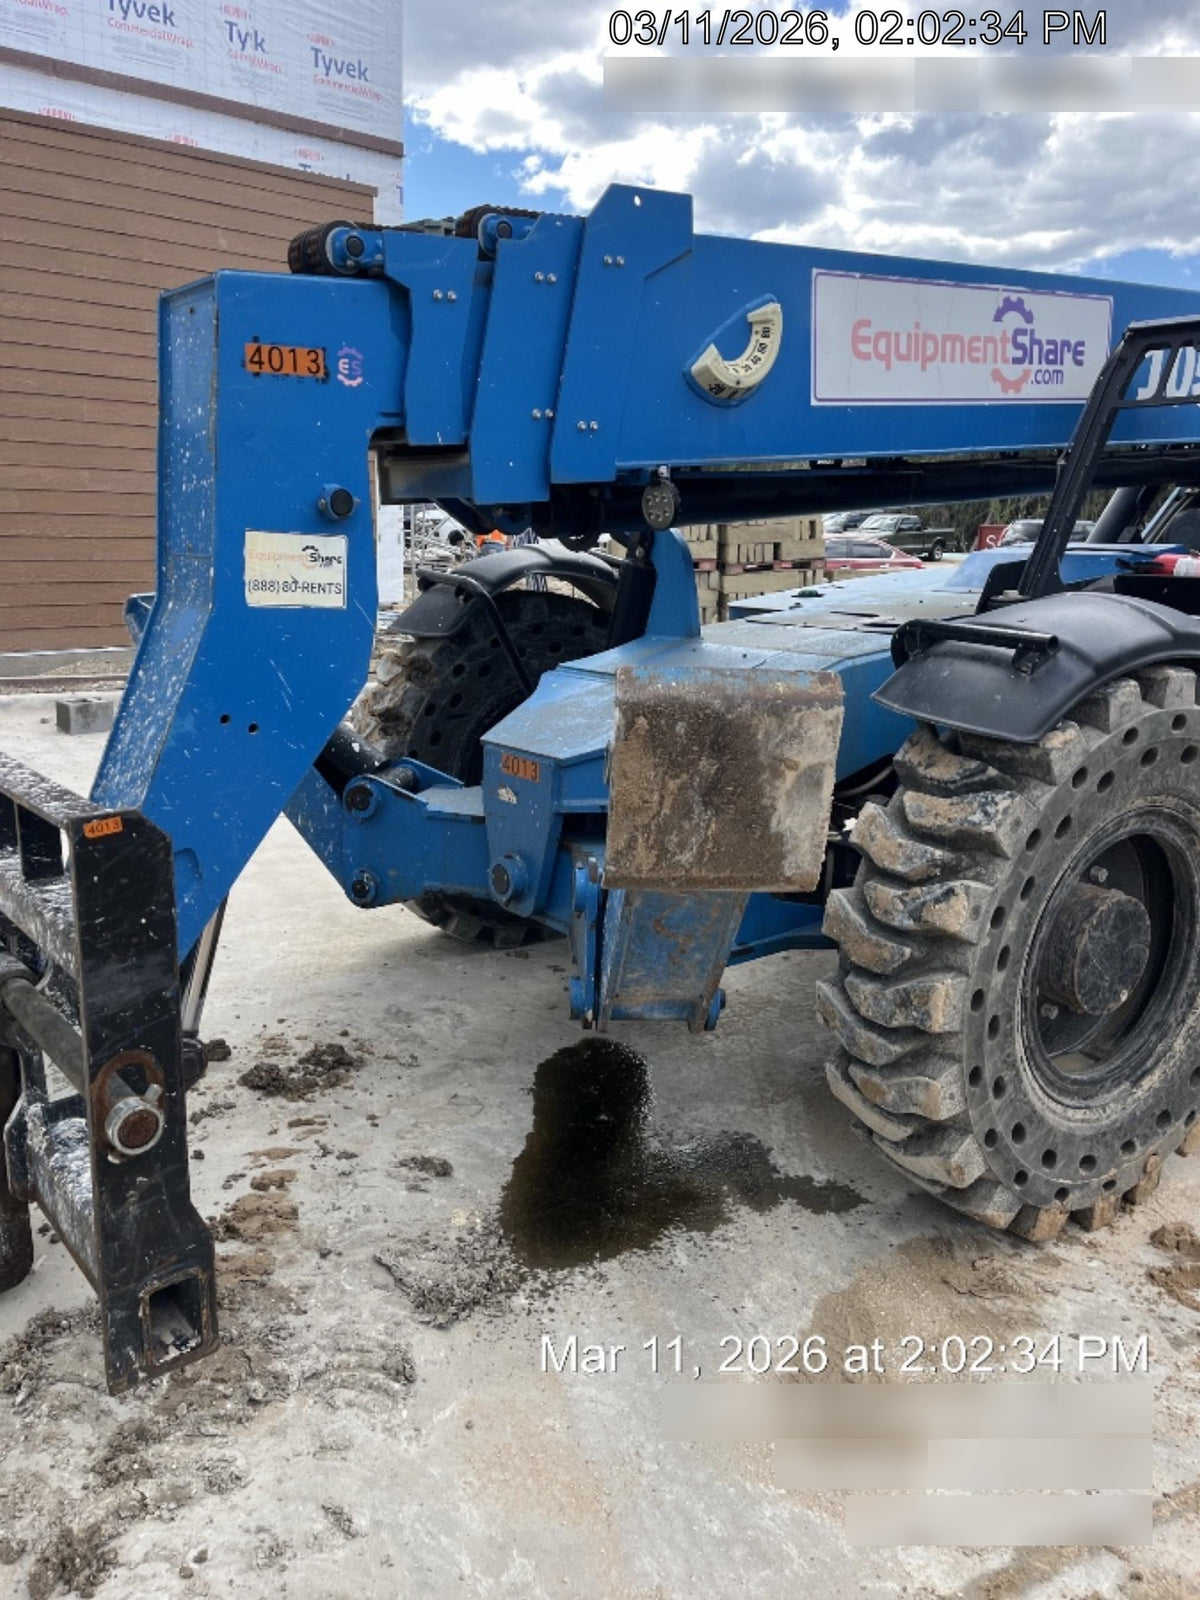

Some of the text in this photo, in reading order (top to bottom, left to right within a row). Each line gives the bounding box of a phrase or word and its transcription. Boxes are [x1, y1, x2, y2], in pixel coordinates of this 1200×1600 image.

[310, 46, 369, 82] Tyvek
[851, 317, 1087, 372] EquipmentShare
[249, 345, 321, 375] 4013
[1030, 368, 1065, 385] .com
[502, 755, 538, 781] 4013
[87, 818, 120, 834] 4013
